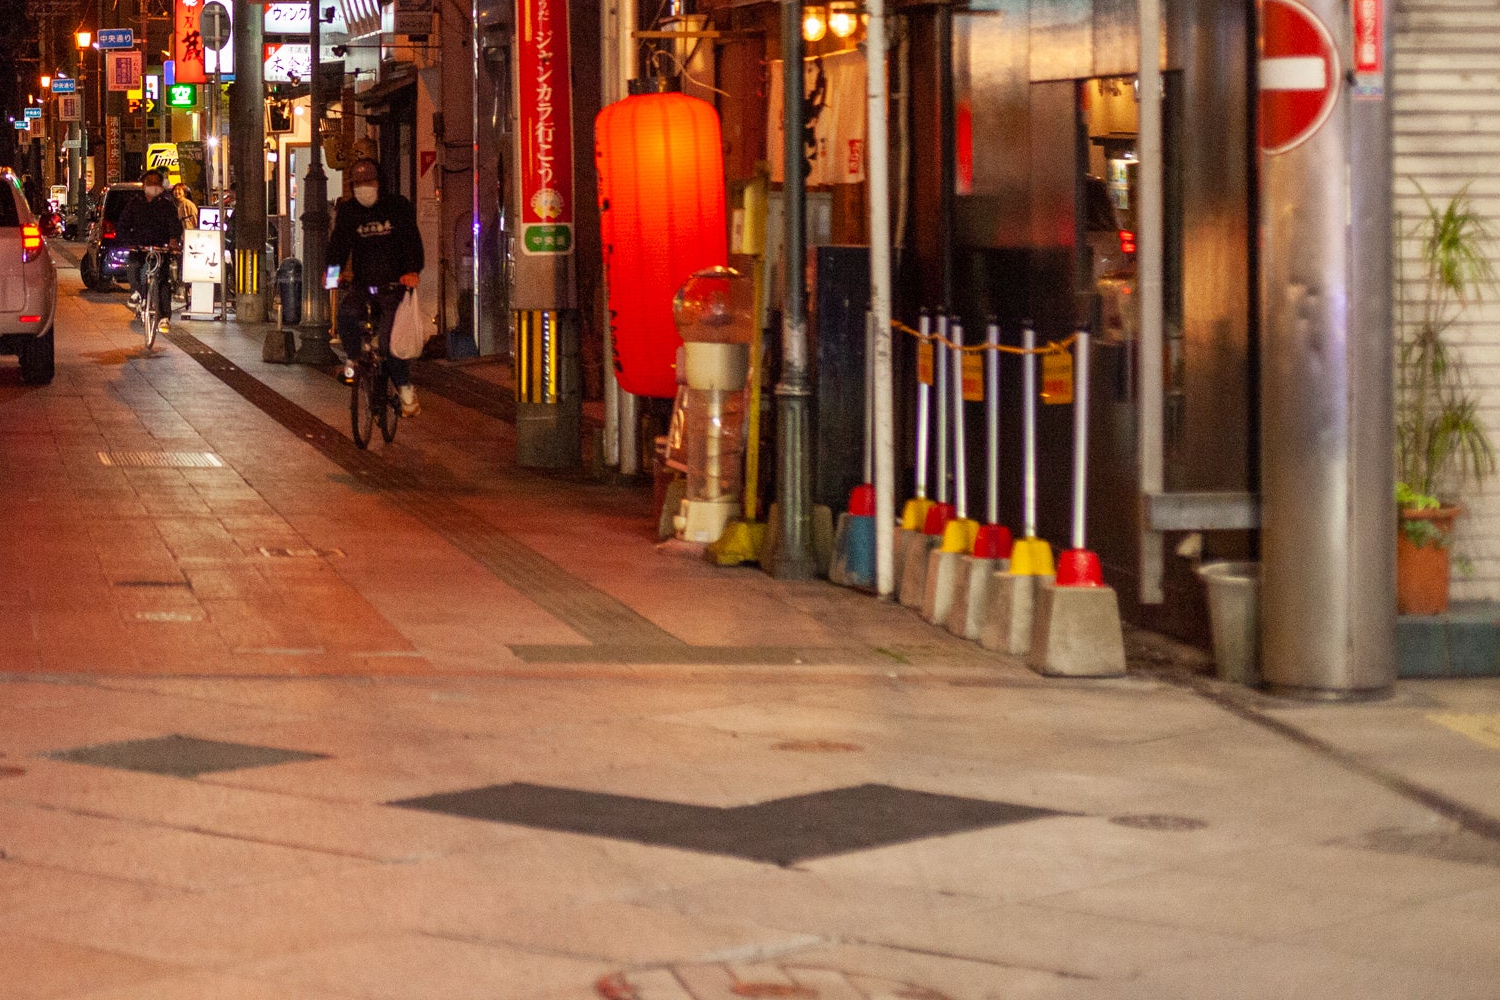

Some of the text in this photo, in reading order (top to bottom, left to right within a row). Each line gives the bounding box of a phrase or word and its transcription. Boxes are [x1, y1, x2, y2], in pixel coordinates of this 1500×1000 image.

[99, 34, 132, 43] 中央通り
[171, 86, 192, 105] 空
